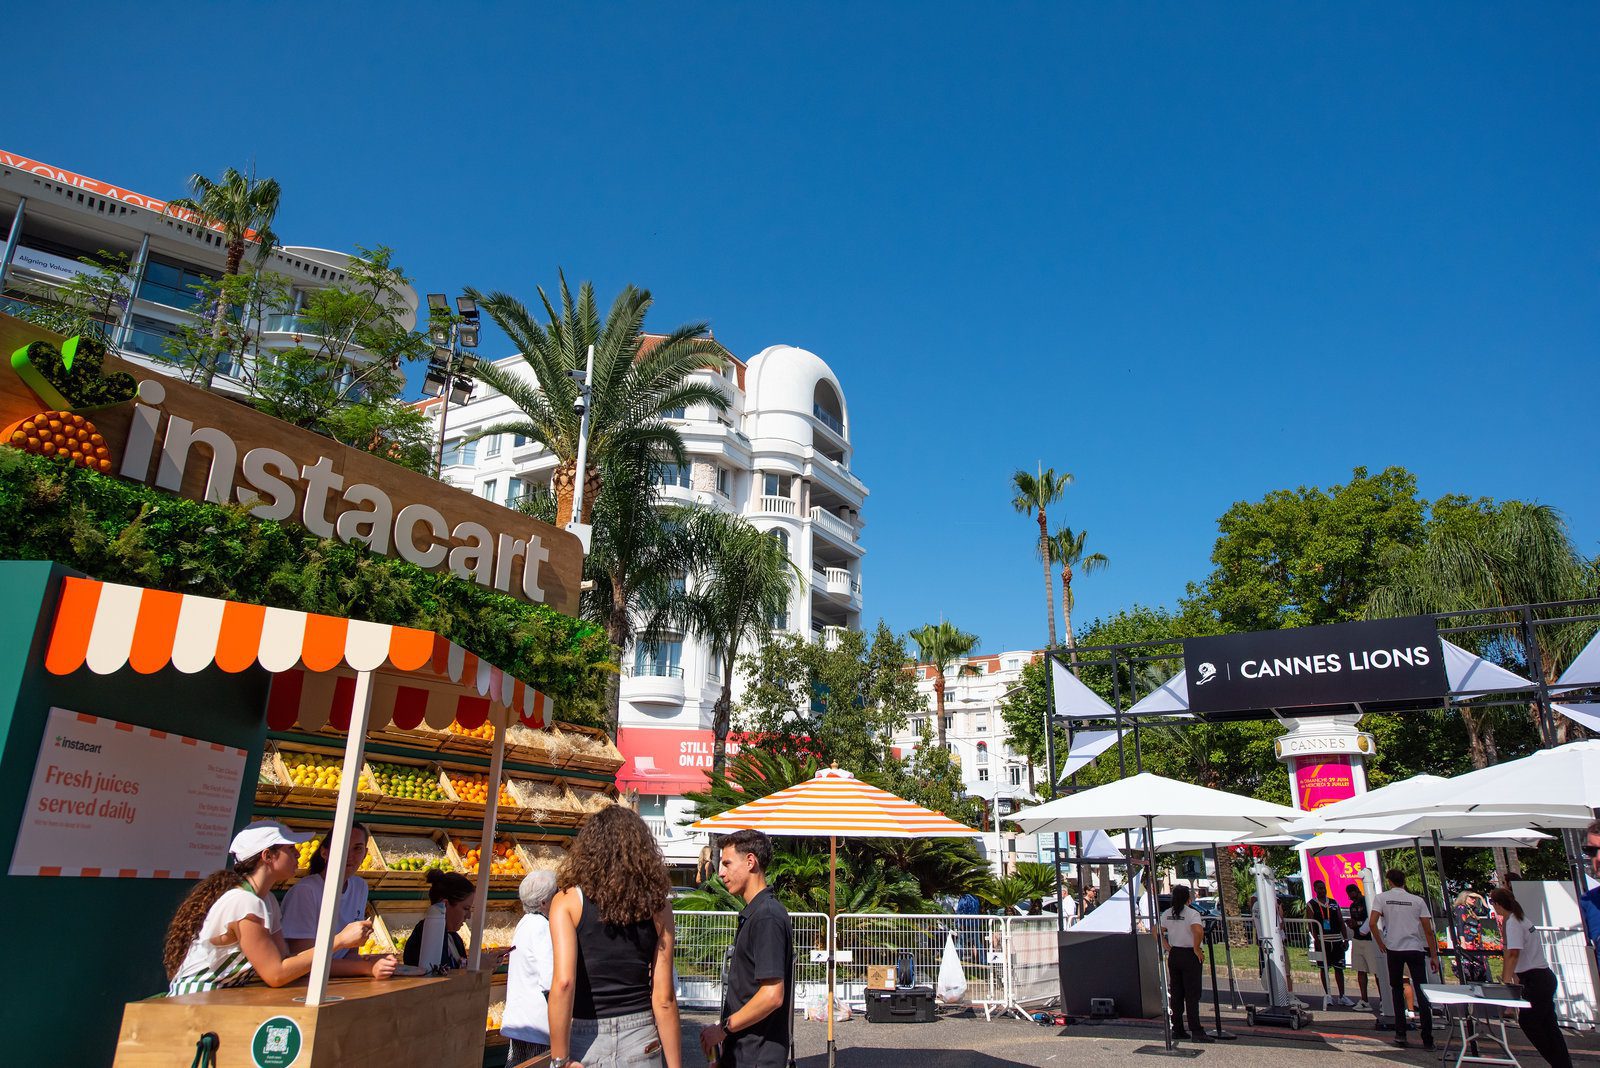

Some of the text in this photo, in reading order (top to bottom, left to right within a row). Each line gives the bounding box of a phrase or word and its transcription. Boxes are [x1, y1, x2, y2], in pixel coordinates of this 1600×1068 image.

[19, 255, 48, 268] Aligning
[49, 262, 73, 274] Values.
[119, 379, 550, 602] instacart
[1240, 646, 1430, 679] CANNES LIONS
[61, 736, 102, 754] instacart
[680, 741, 708, 754] STILL
[1290, 738, 1346, 751] CANNES
[679, 755, 694, 767] ON
[696, 755, 704, 767] A
[45, 765, 140, 796] Fresh juices
[38, 797, 136, 824] served daily
[1344, 861, 1361, 874] 5€
